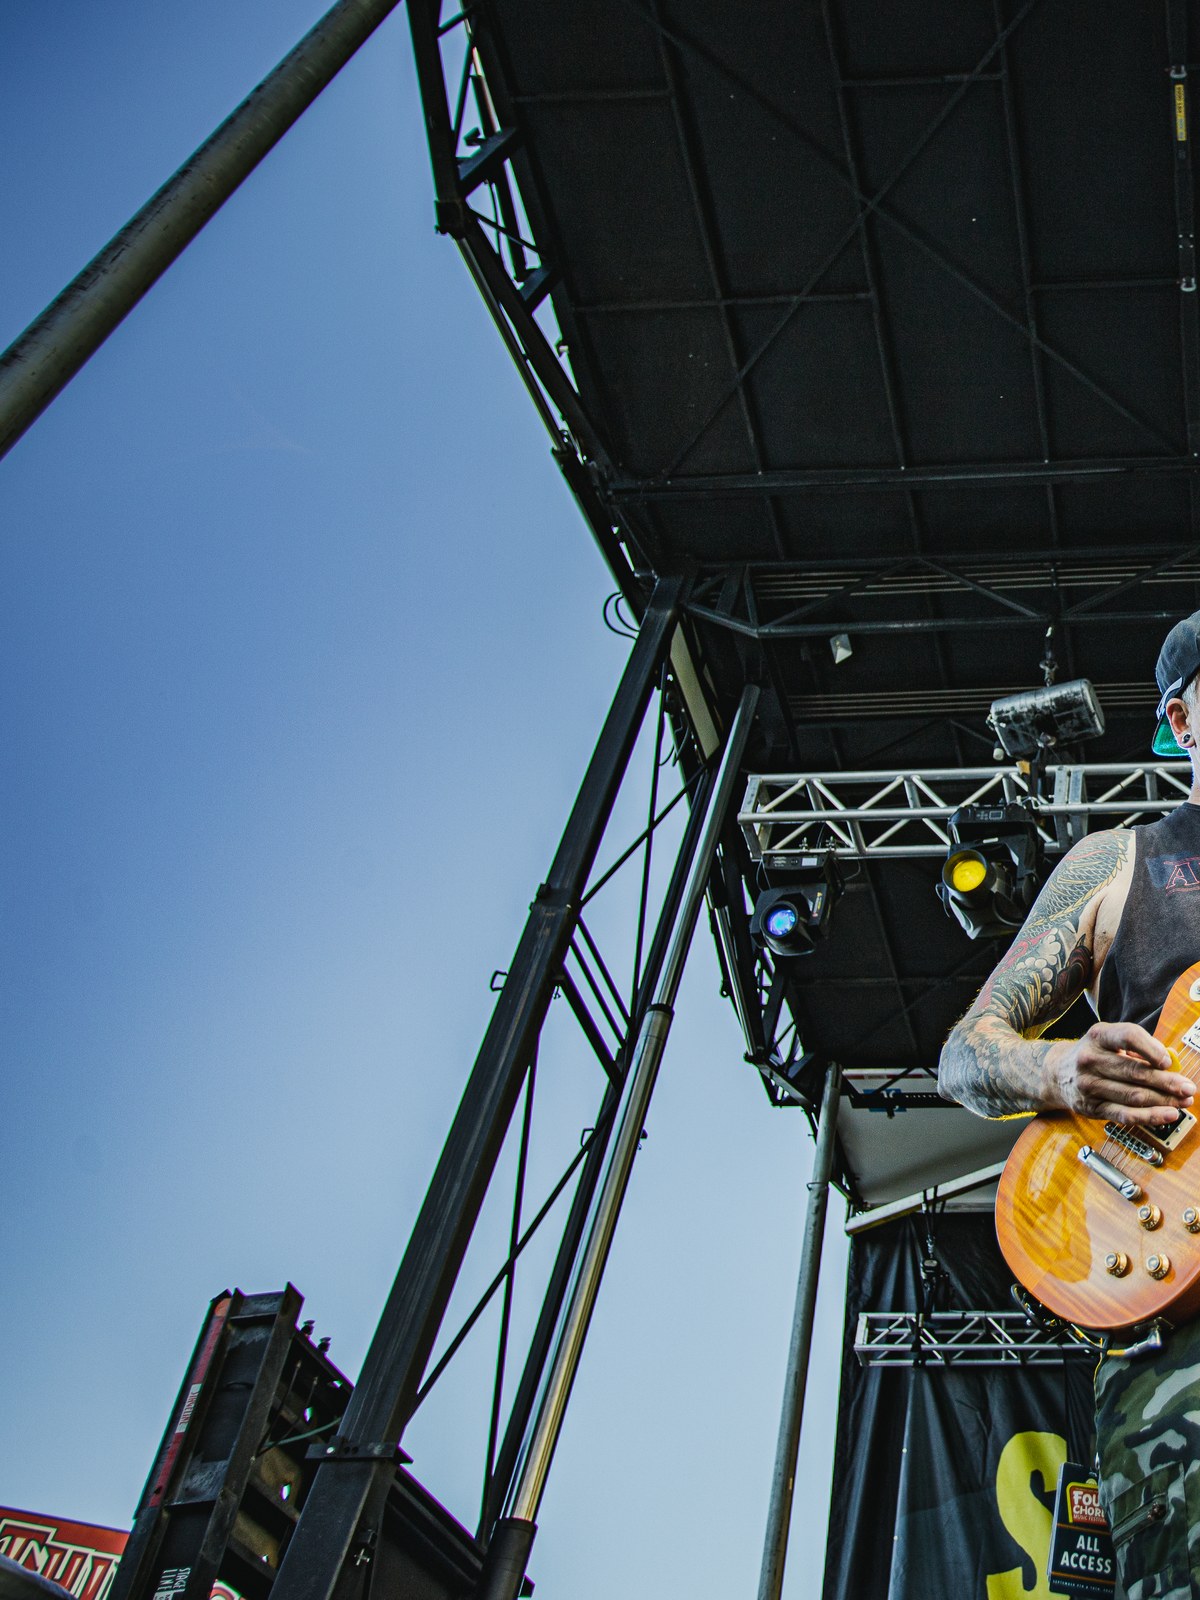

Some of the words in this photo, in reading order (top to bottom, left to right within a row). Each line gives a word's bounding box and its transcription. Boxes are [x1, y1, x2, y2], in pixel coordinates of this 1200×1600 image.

[1166, 862, 1200, 889] A
[1072, 1490, 1100, 1507] FOU
[1076, 1534, 1100, 1552] ALL
[1060, 1551, 1112, 1574] ACCESS
